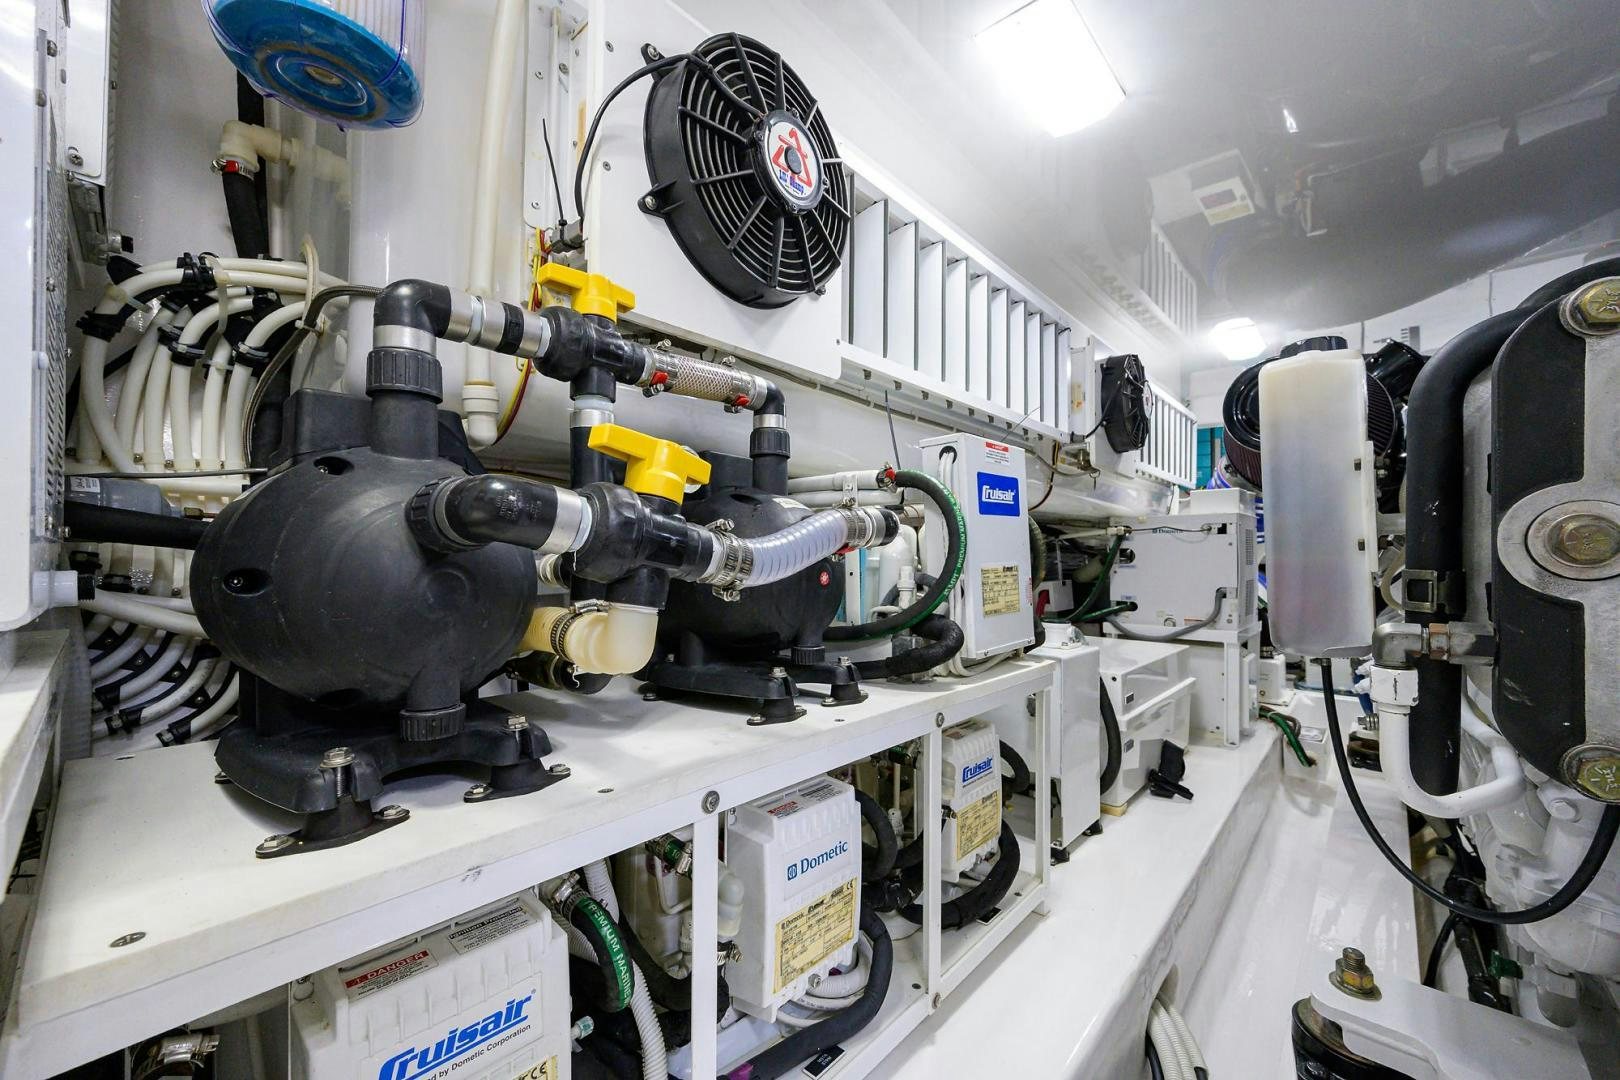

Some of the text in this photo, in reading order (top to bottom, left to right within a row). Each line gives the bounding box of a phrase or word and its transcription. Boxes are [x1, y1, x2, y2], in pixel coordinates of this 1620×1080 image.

[981, 485, 1015, 504] Cruisair
[962, 757, 993, 783] Cruisair
[800, 841, 849, 874] Dometic
[367, 952, 426, 979] DANGER
[616, 953, 632, 998] MARINE
[377, 995, 532, 1080] Cruisair
[439, 1024, 531, 1078] by Dometic Corporation
